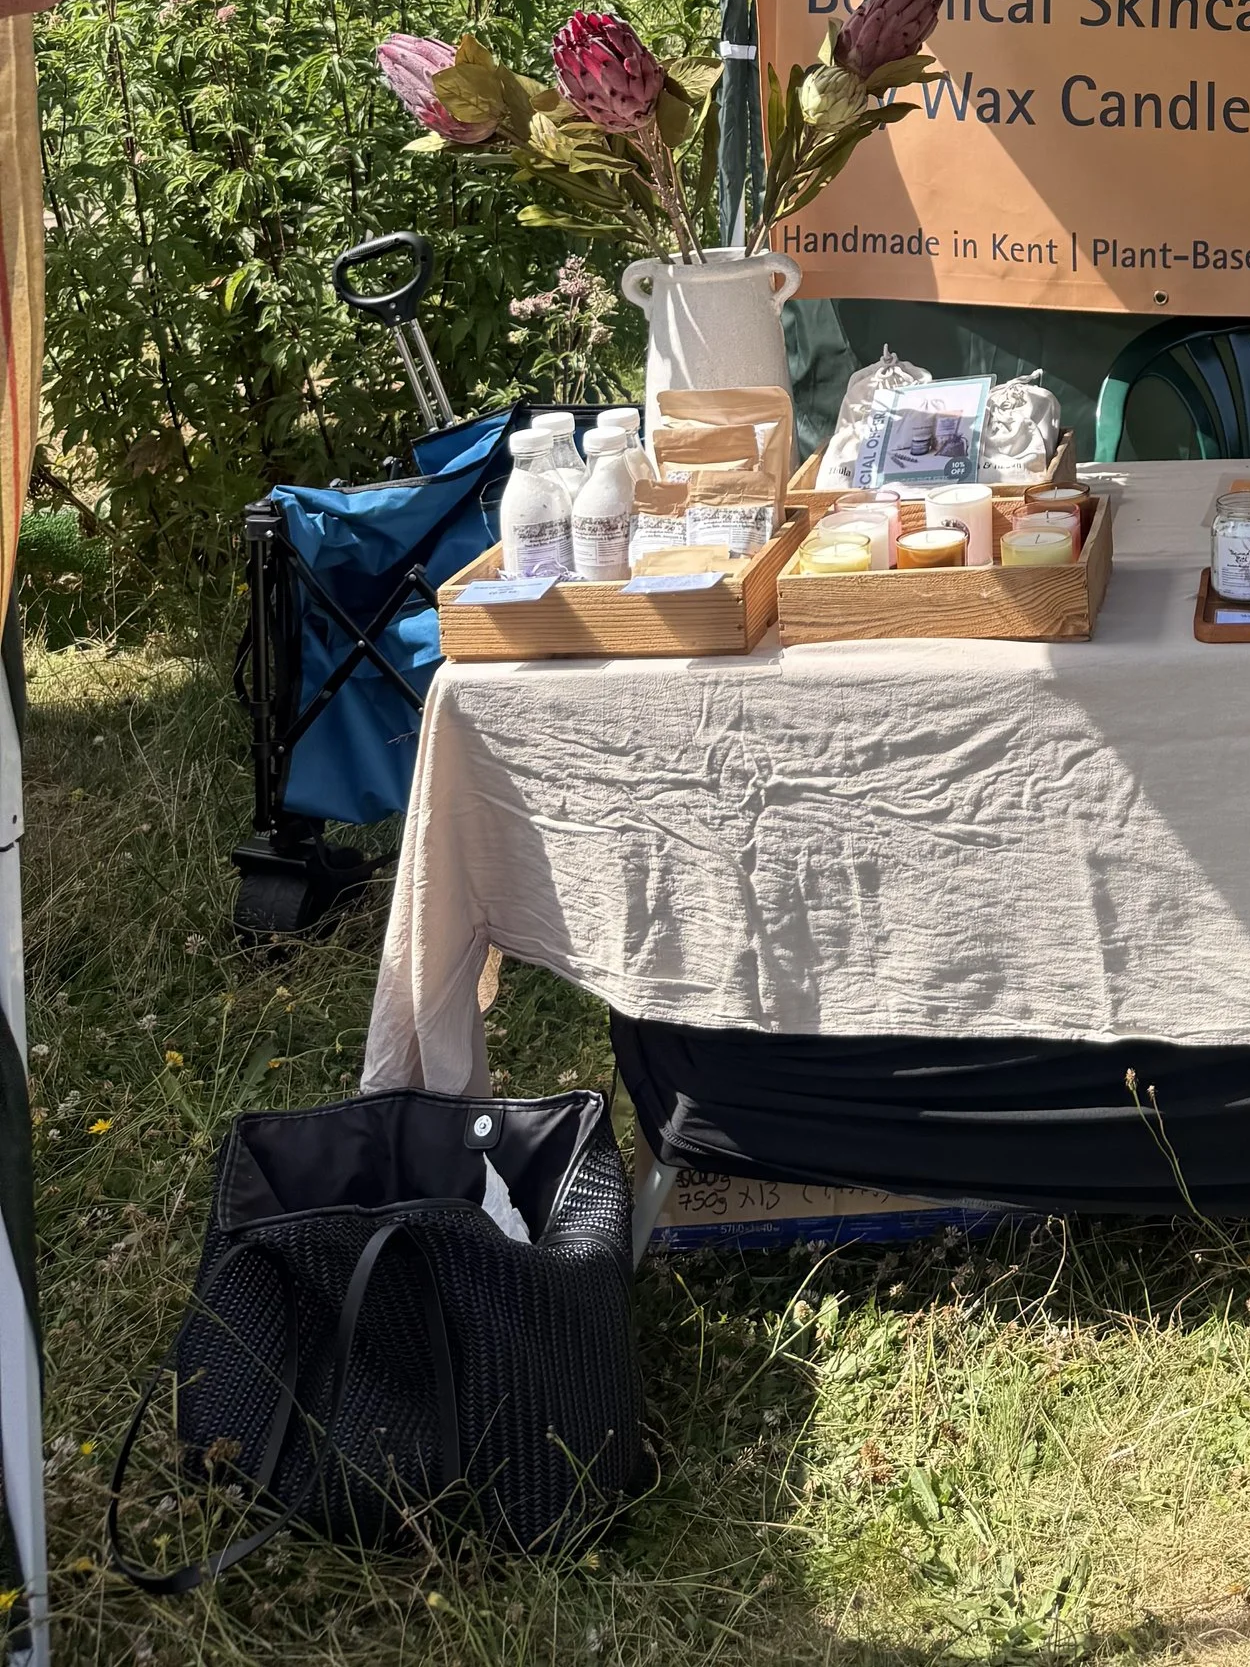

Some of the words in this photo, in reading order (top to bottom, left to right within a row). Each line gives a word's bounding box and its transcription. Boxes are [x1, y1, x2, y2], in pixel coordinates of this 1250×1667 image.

[921, 71, 1036, 126] Wax
[783, 225, 940, 259] Handmade
[953, 230, 978, 260] in
[992, 233, 1058, 265] Kent
[678, 1190, 728, 1215] 750g
